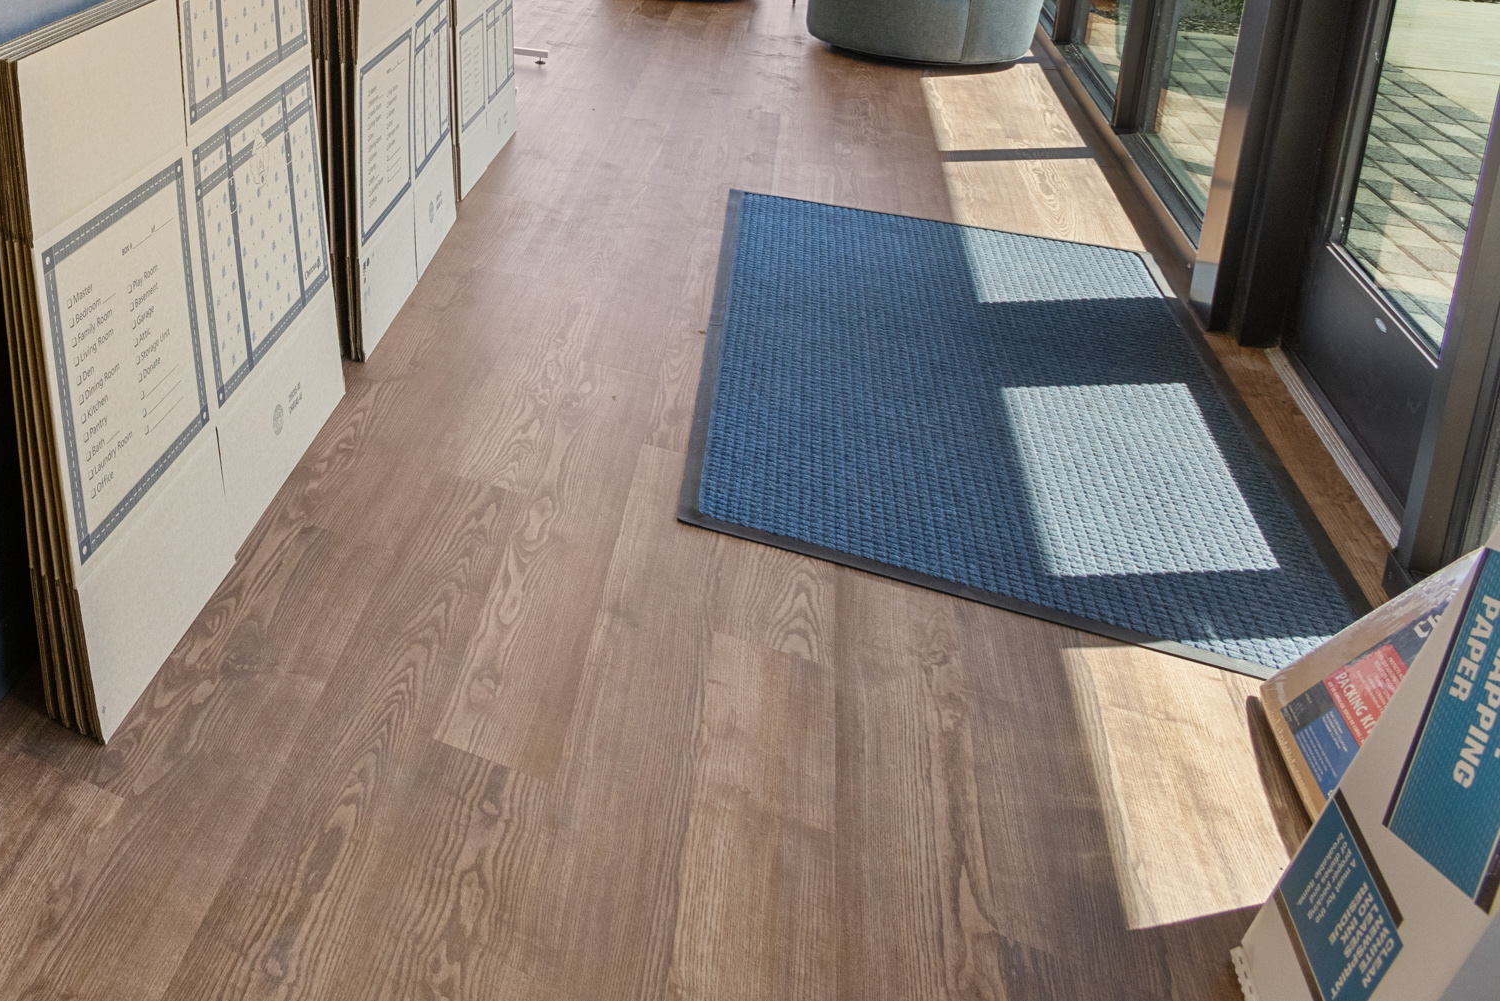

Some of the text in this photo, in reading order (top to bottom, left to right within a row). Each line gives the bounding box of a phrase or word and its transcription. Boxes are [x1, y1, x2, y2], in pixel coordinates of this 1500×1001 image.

[73, 284, 93, 305] Master
[132, 264, 158, 290] Play Room
[75, 298, 102, 324] Bedroom
[134, 282, 158, 308] Basement
[77, 308, 113, 343] Family Room
[136, 305, 155, 326] Garage
[79, 328, 114, 362] Living Room
[138, 327, 151, 342] Attic
[140, 329, 170, 362] Storage Unit
[82, 366, 94, 382] Den
[84, 363, 120, 400] Dining Room
[143, 356, 161, 378] Donate
[86, 394, 109, 417] Kitchen
[89, 416, 108, 438] Pantry
[91, 438, 105, 457] Bath
[94, 431, 133, 476] Laundry Room
[96, 471, 114, 493] Office
[1449, 594, 1500, 702] PAPER
[1334, 671, 1368, 716] PACKING
[1296, 832, 1345, 906] breakable items.
[1307, 848, 1352, 920] proper packing
[1309, 841, 1348, 904] of dishes and
[1315, 857, 1356, 924] A must for the
[1328, 881, 1369, 946] RESIDUE
[1340, 893, 1374, 945] NO INK
[1343, 903, 1379, 959] LEAVES
[1330, 914, 1384, 1000] NEWSPRINT
[1358, 927, 1391, 974] WHITE
[1361, 937, 1395, 988] CLEAN
